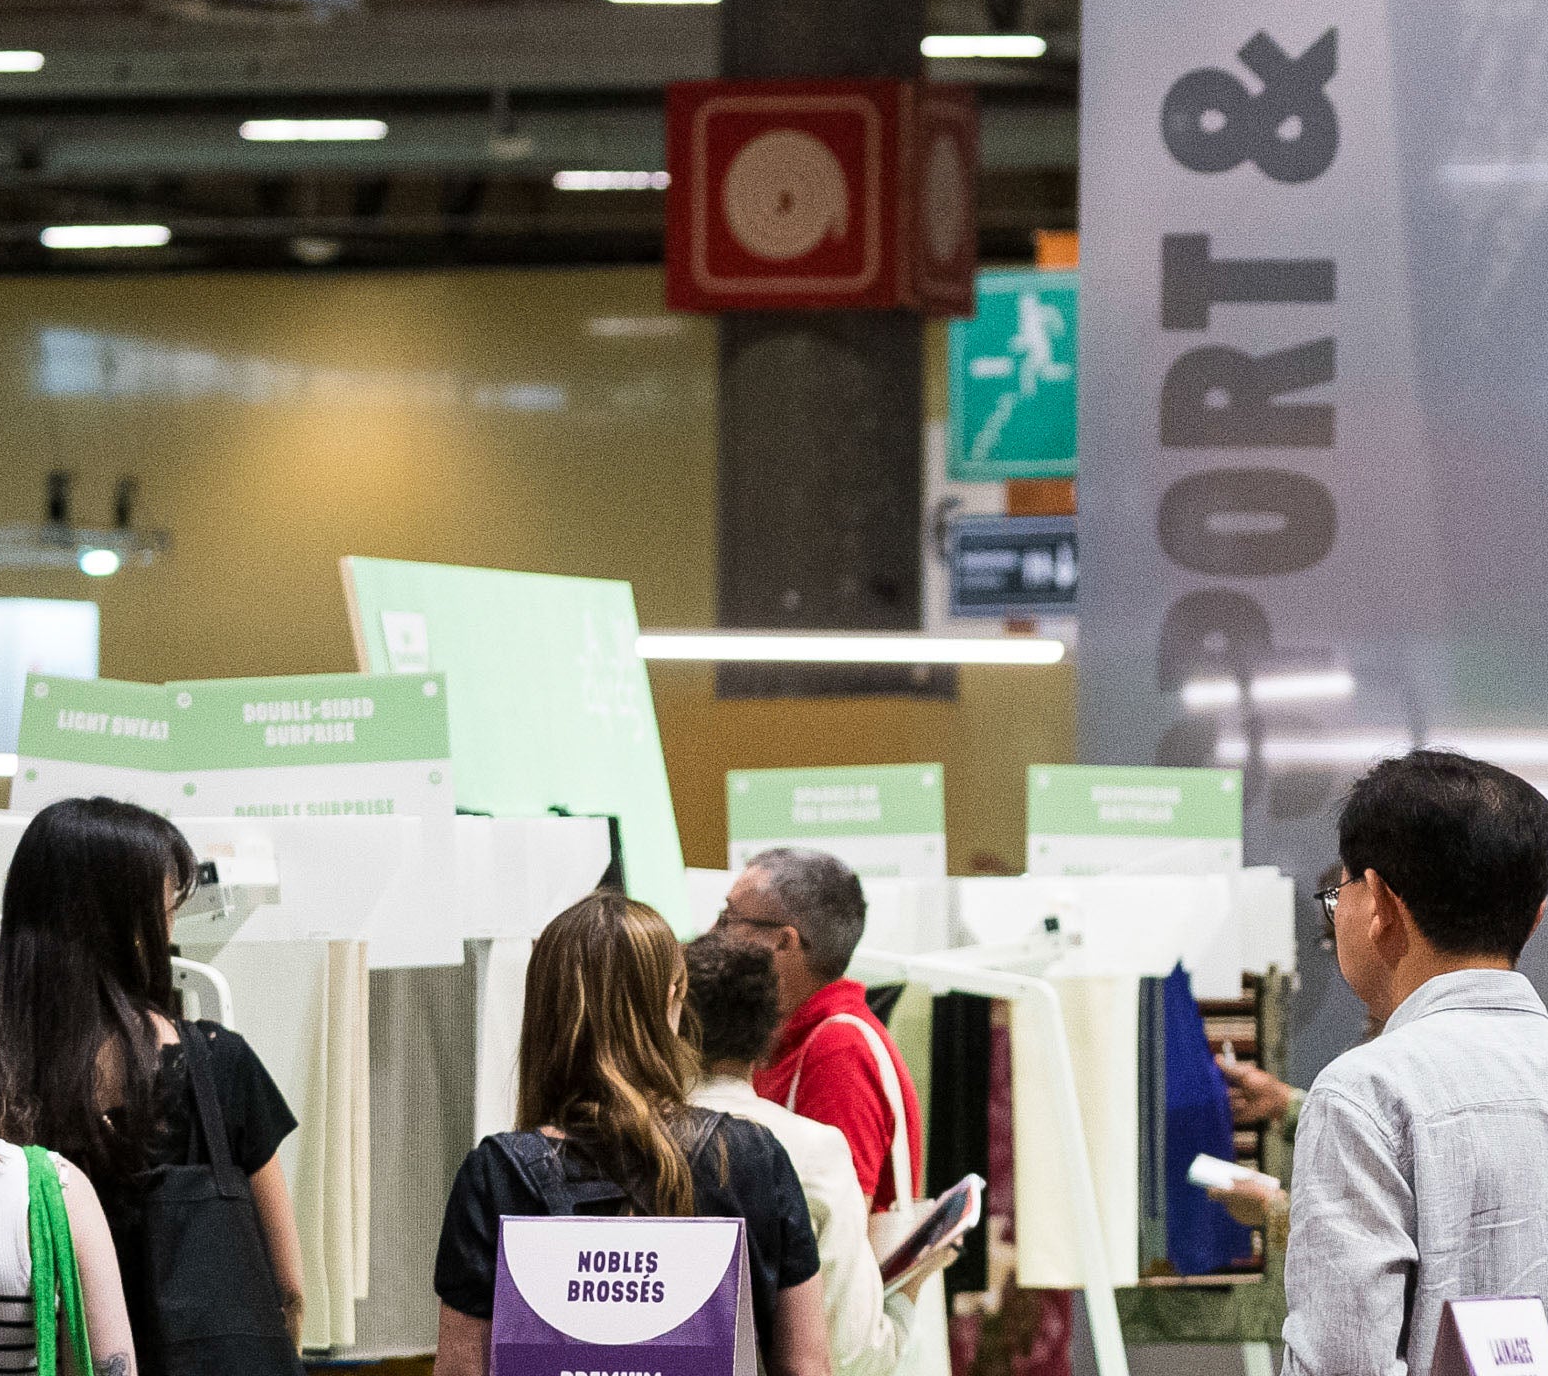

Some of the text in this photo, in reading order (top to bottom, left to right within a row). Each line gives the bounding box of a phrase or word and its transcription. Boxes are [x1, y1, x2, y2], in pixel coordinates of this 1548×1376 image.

[1161, 26, 1340, 184] &
[577, 1250, 659, 1273] NOBLES
[567, 1274, 665, 1303] BROSSÉS
